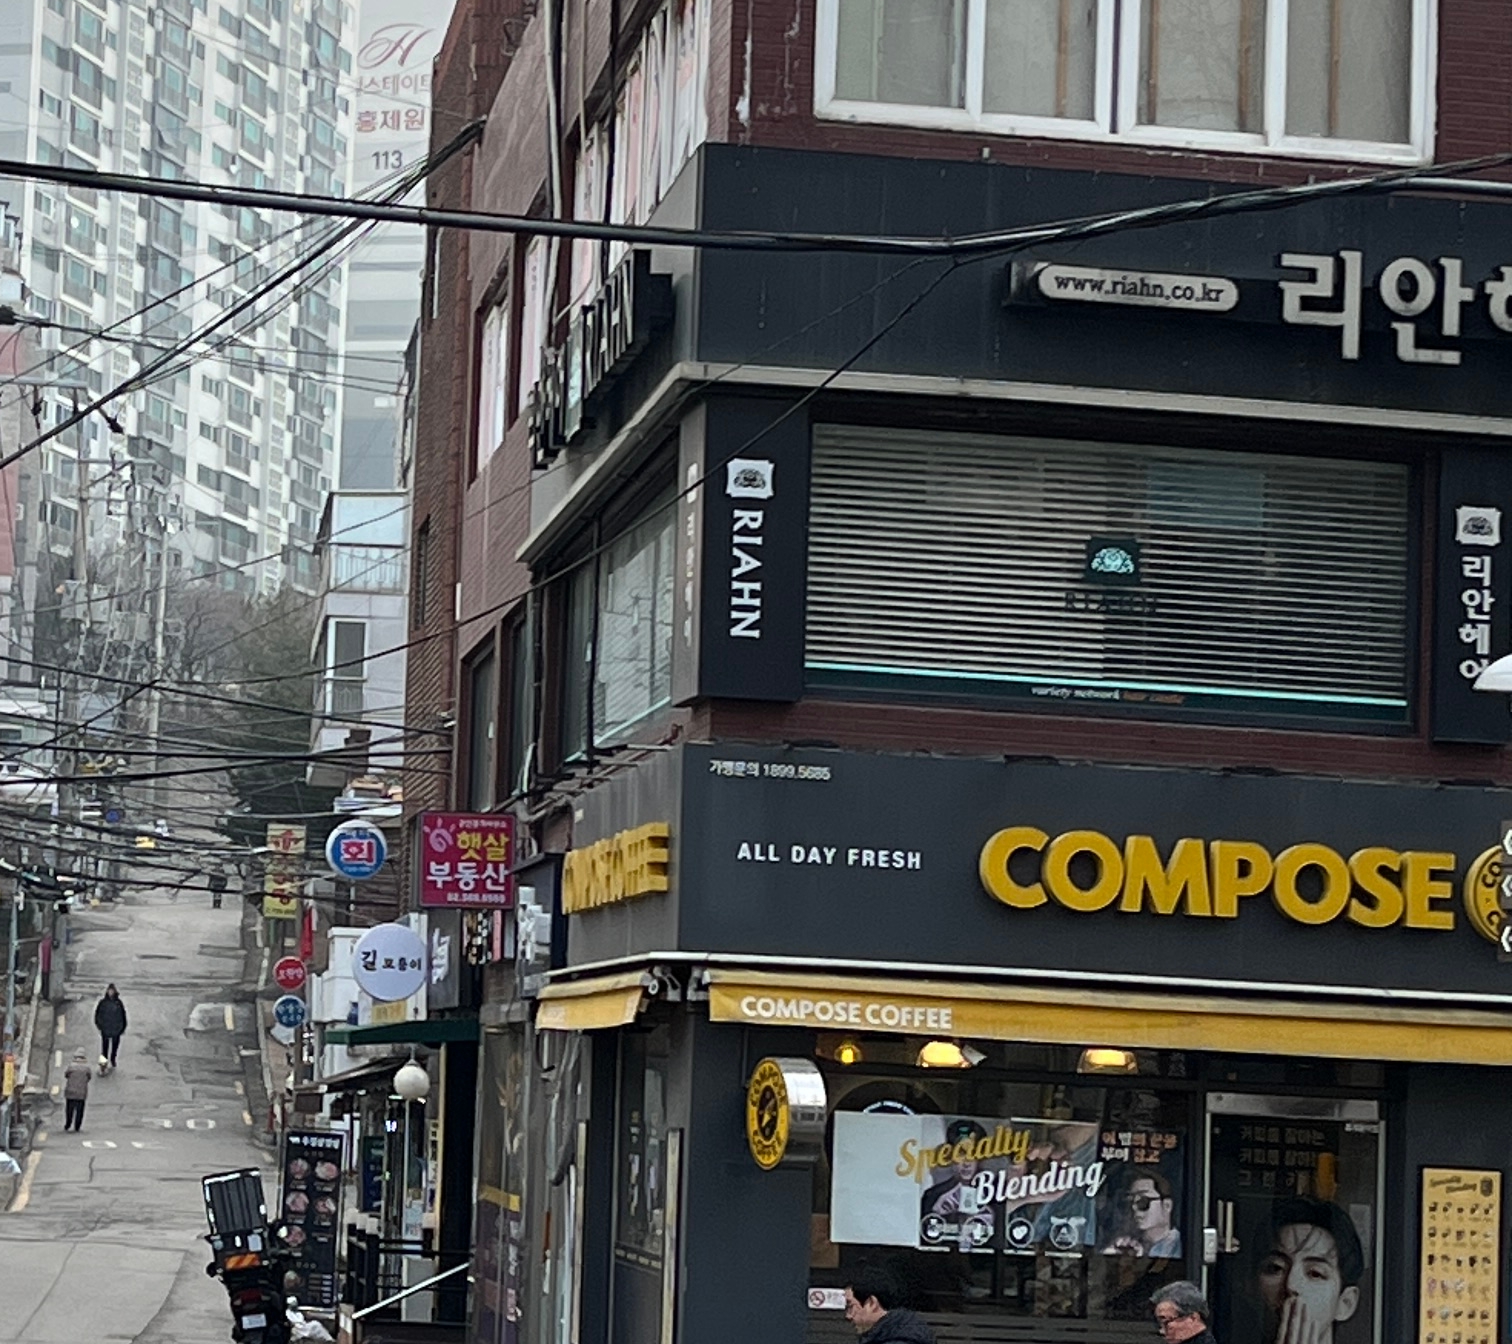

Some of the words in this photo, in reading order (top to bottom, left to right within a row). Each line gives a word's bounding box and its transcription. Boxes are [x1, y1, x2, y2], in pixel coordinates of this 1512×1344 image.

[355, 107, 425, 133] 홍제원
[371, 149, 404, 171] 113
[1053, 269, 1225, 306] www.riahn.co.kr
[728, 508, 764, 641] RIAHN
[455, 830, 510, 862] 햇살
[737, 842, 781, 862] ALL
[791, 845, 836, 864] DAY
[847, 848, 922, 870] FRESH
[425, 861, 509, 892] 부동산
[978, 825, 1457, 931] COMPOSE
[740, 995, 862, 1024] COMPOSE
[864, 1003, 953, 1030] COFFEE
[895, 1125, 1031, 1184] Specialty
[971, 1159, 1107, 1205] Blending
